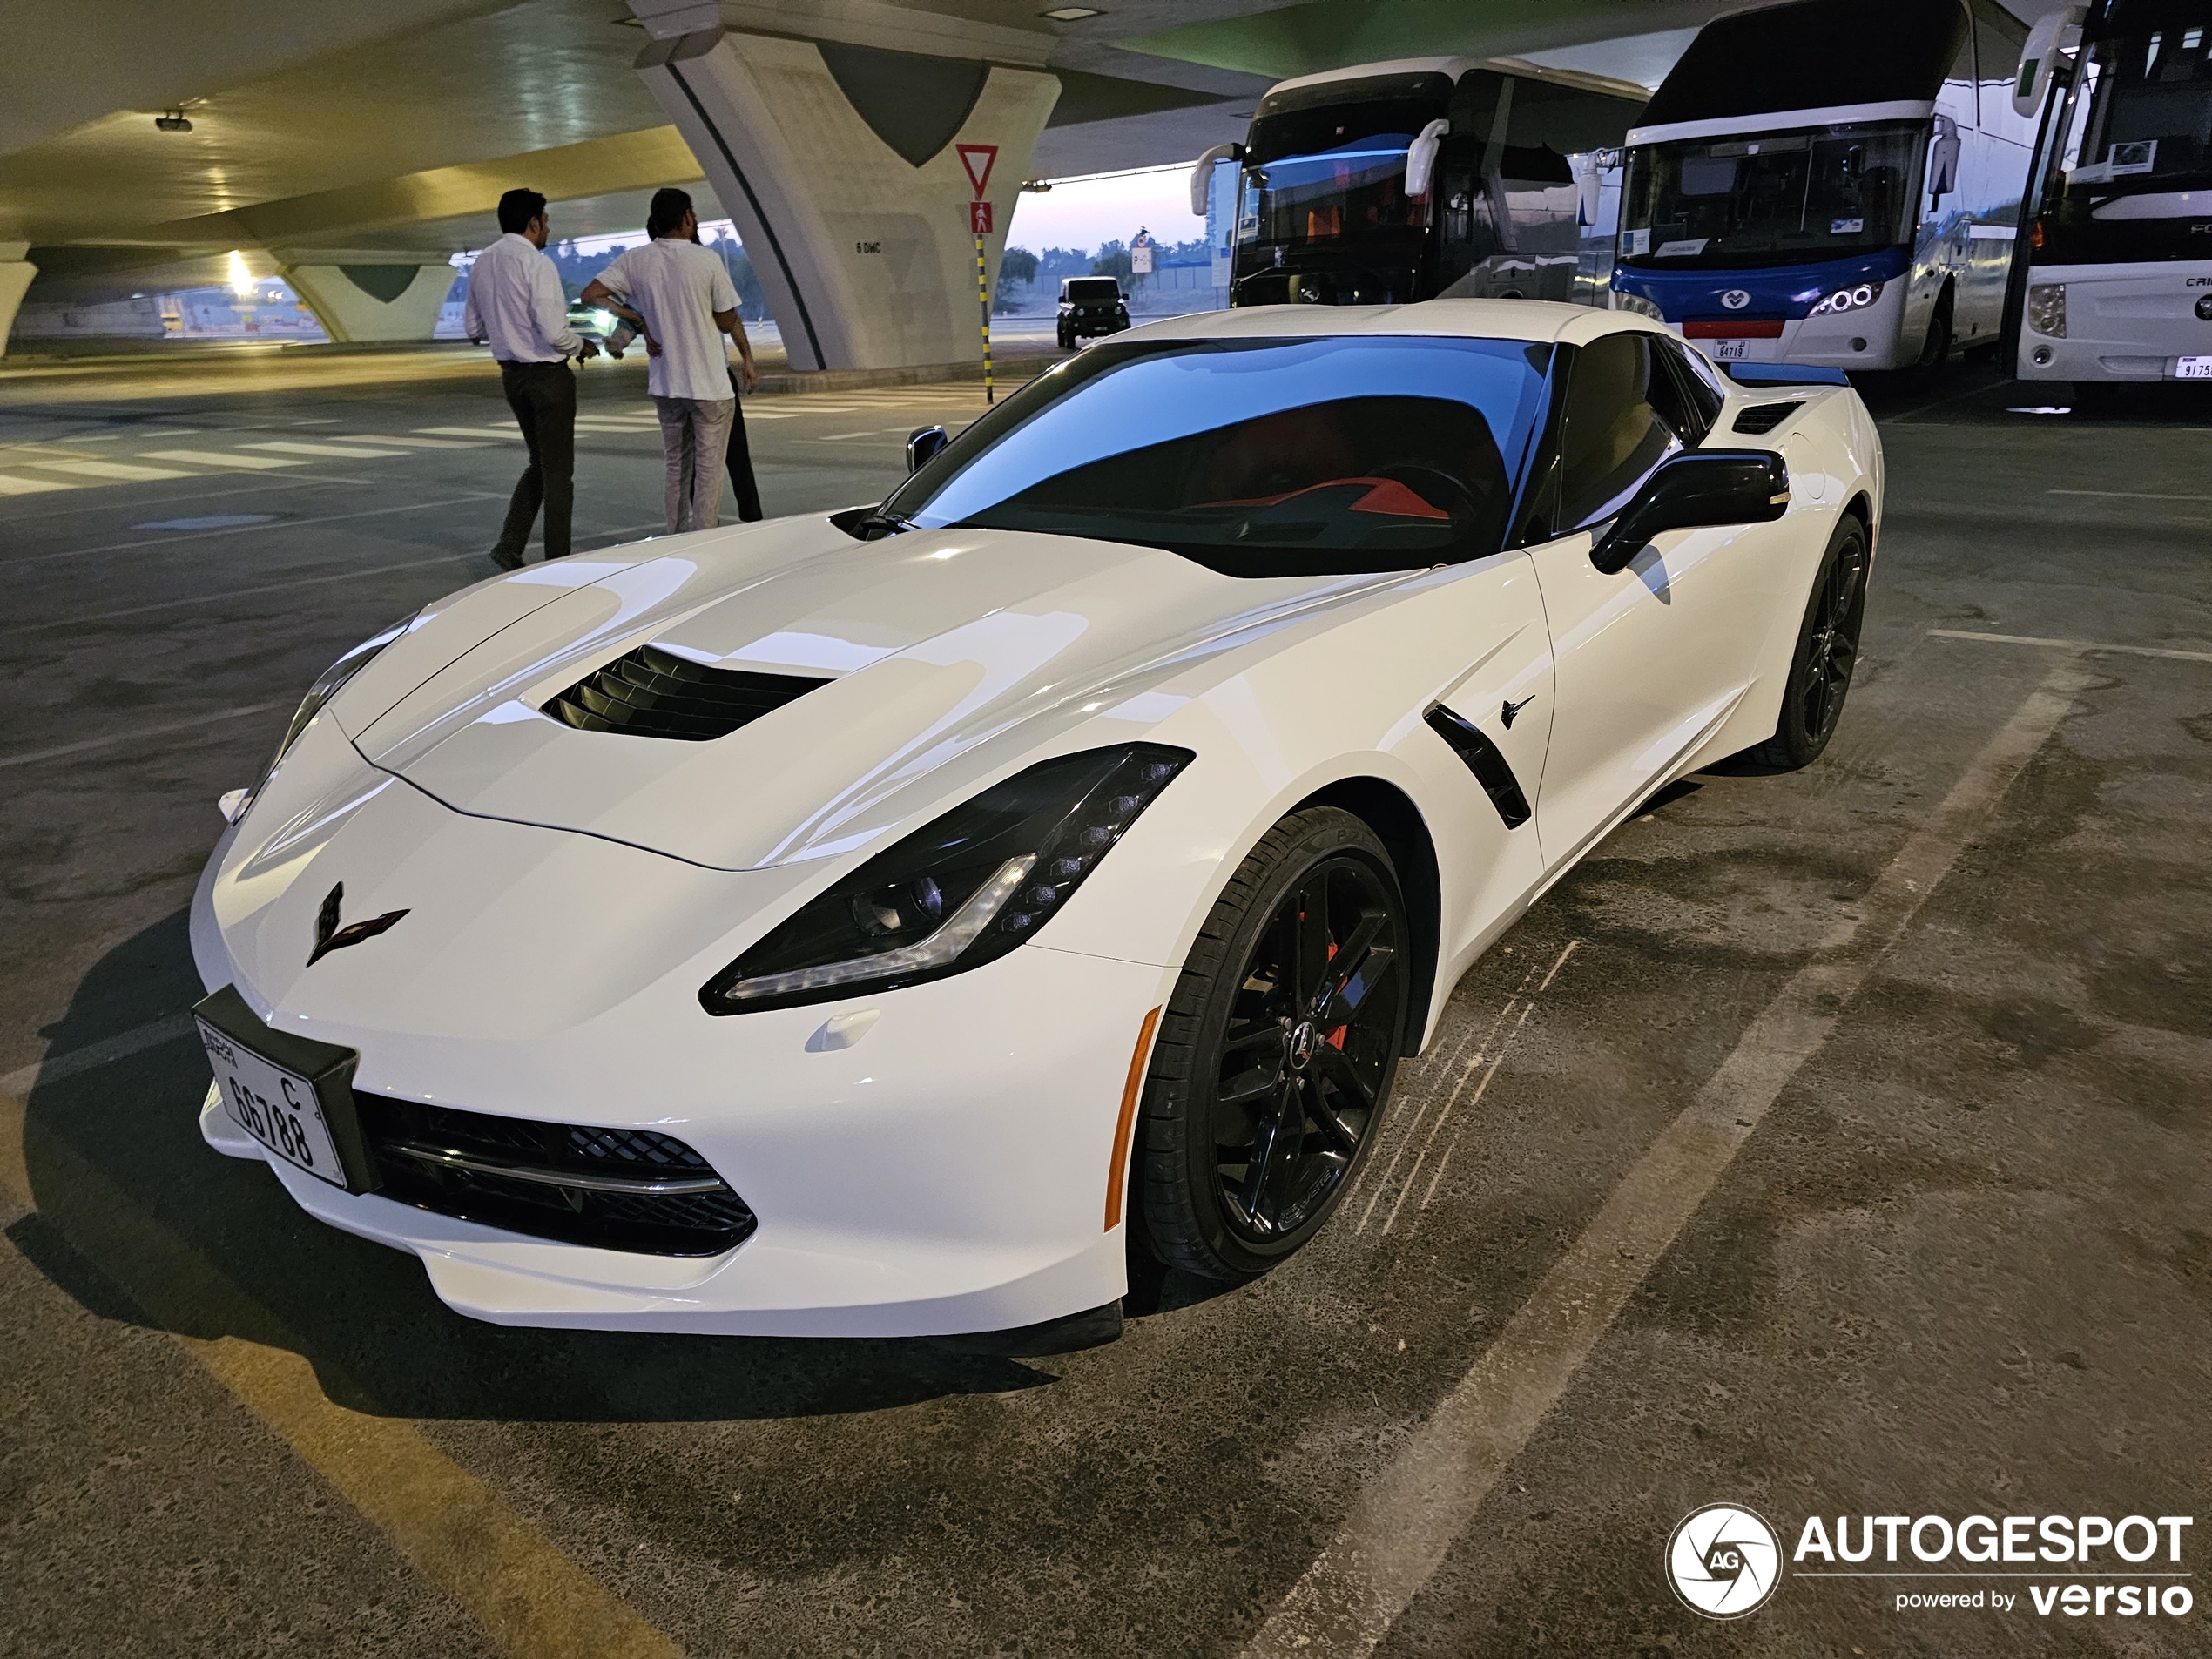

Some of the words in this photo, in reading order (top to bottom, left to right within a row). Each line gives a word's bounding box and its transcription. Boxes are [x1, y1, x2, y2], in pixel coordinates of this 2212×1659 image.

[2185, 365, 2212, 376] 9175
[280, 1077, 300, 1110] C
[229, 1076, 313, 1167] 66788
